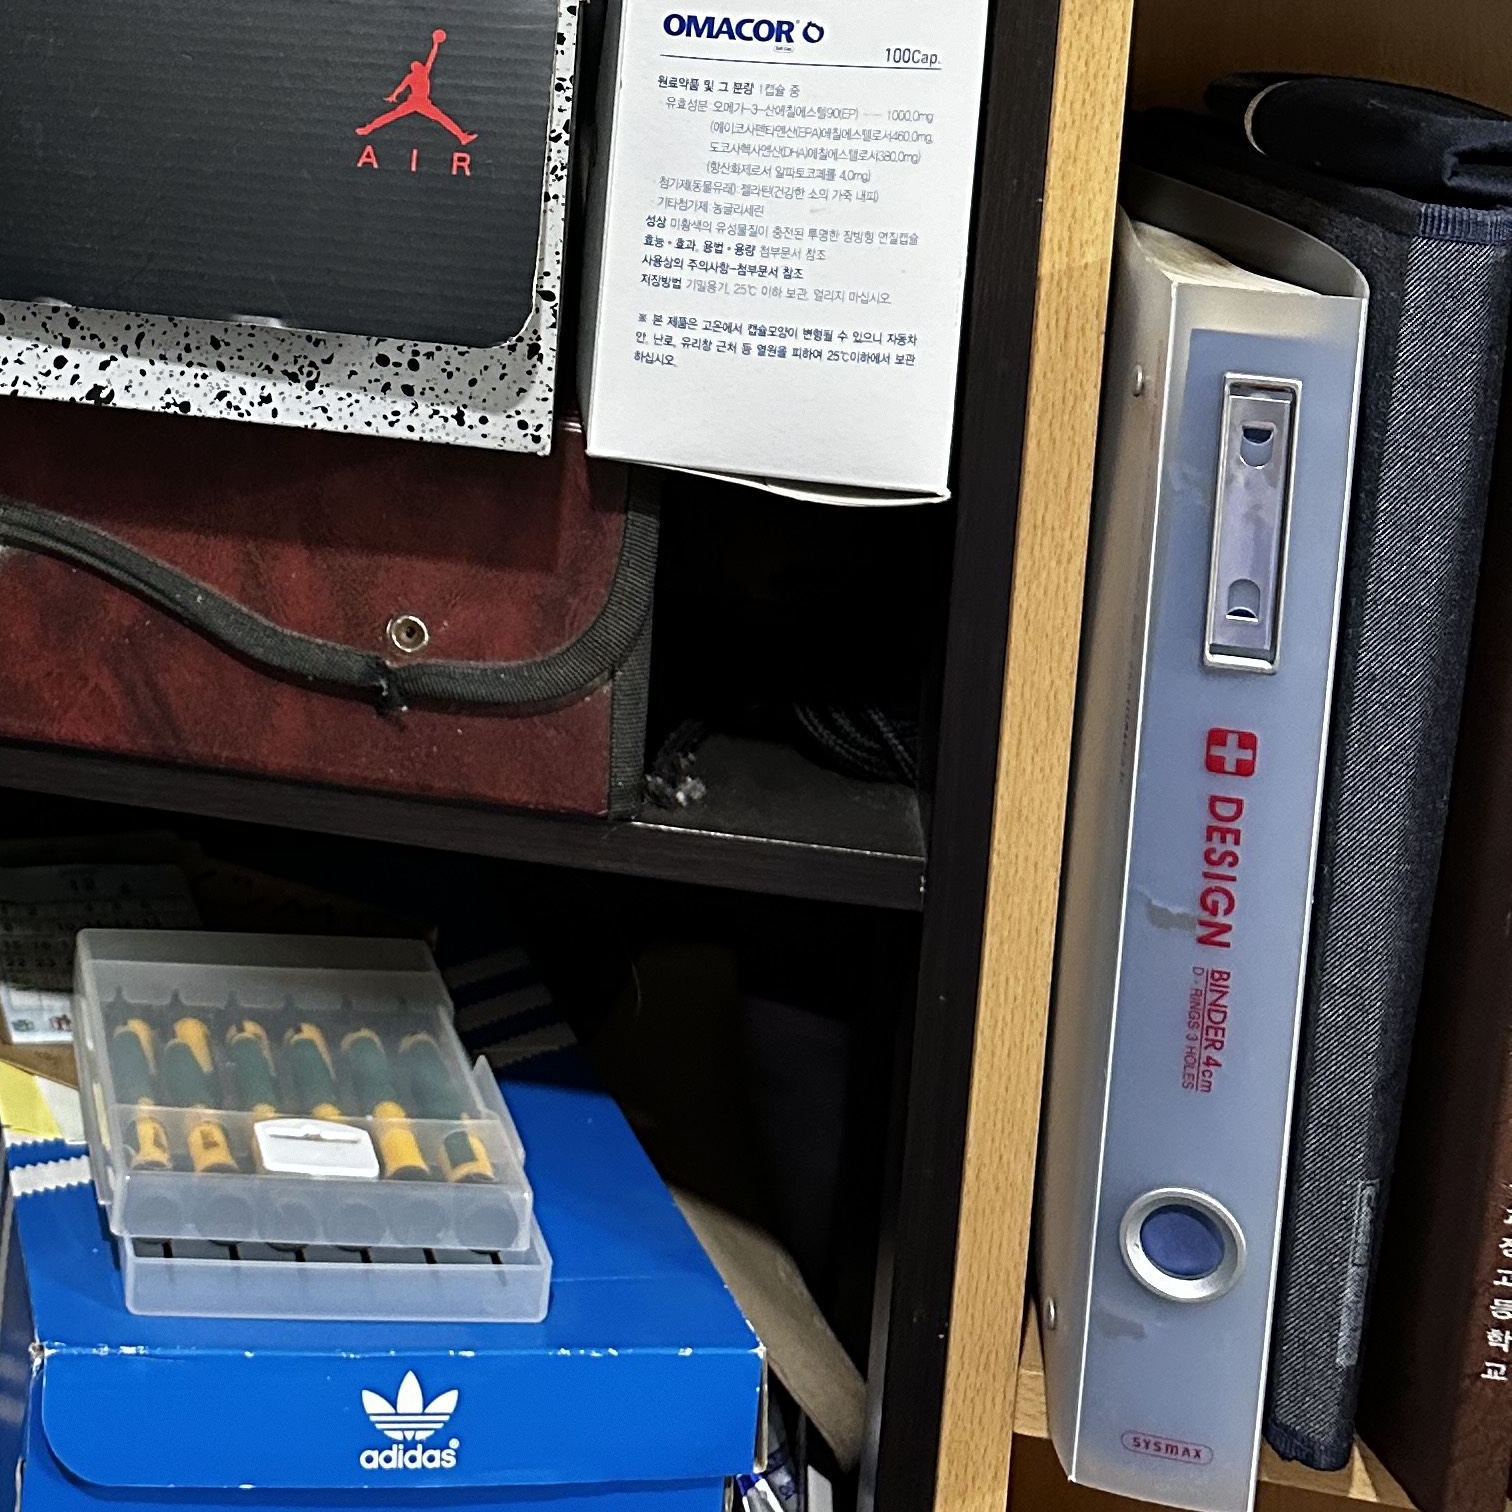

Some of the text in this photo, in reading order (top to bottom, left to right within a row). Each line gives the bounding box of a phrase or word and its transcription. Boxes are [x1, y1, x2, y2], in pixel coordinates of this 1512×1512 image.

[663, 13, 795, 43] OMACOR
[356, 145, 471, 176] AIR
[1196, 794, 1245, 949] DESIGN
[1204, 968, 1231, 1052] BINDER
[1181, 1045, 1197, 1090] HOLES
[359, 1443, 458, 1471] adidas
[1132, 1437, 1204, 1461] SYSMAX
